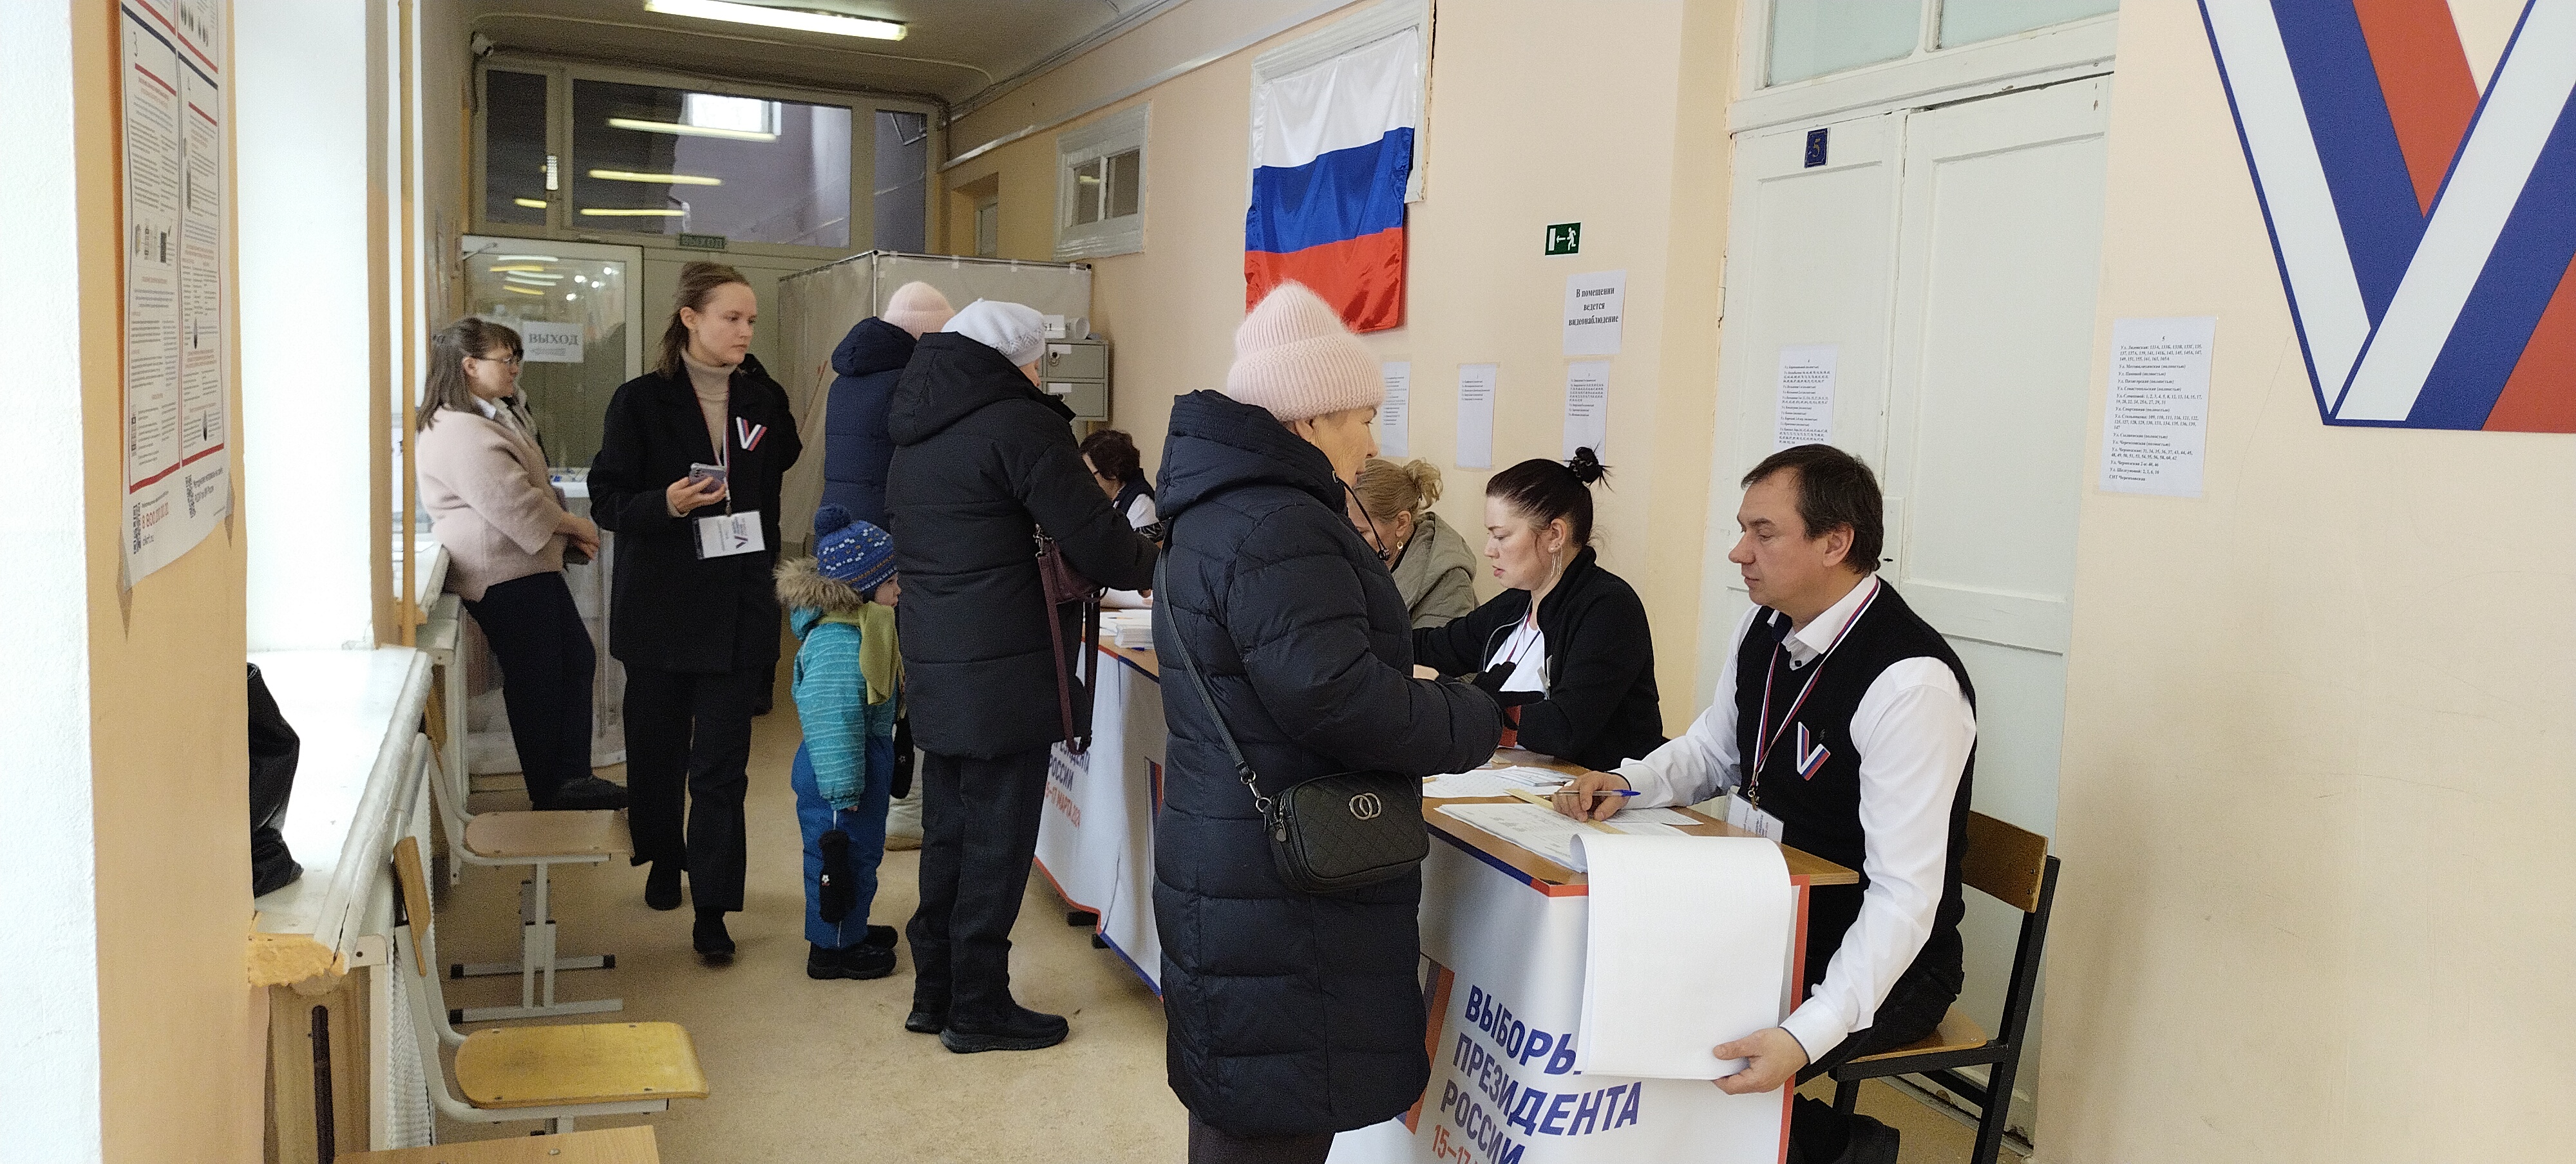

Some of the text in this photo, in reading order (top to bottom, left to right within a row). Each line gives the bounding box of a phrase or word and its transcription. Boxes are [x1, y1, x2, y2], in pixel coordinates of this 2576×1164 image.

[1812, 138, 1821, 158] 5
[1576, 286, 1615, 299] В помещении
[1584, 302, 1605, 312] ведется
[1569, 314, 1618, 327] видеонаблюдение
[528, 333, 579, 346] ВЫХОД
[1049, 754, 1074, 792] РОССИИ
[1452, 1032, 1642, 1137] ПРЕЗИДЕНТА
[1440, 1078, 1526, 1164] РОССИИ
